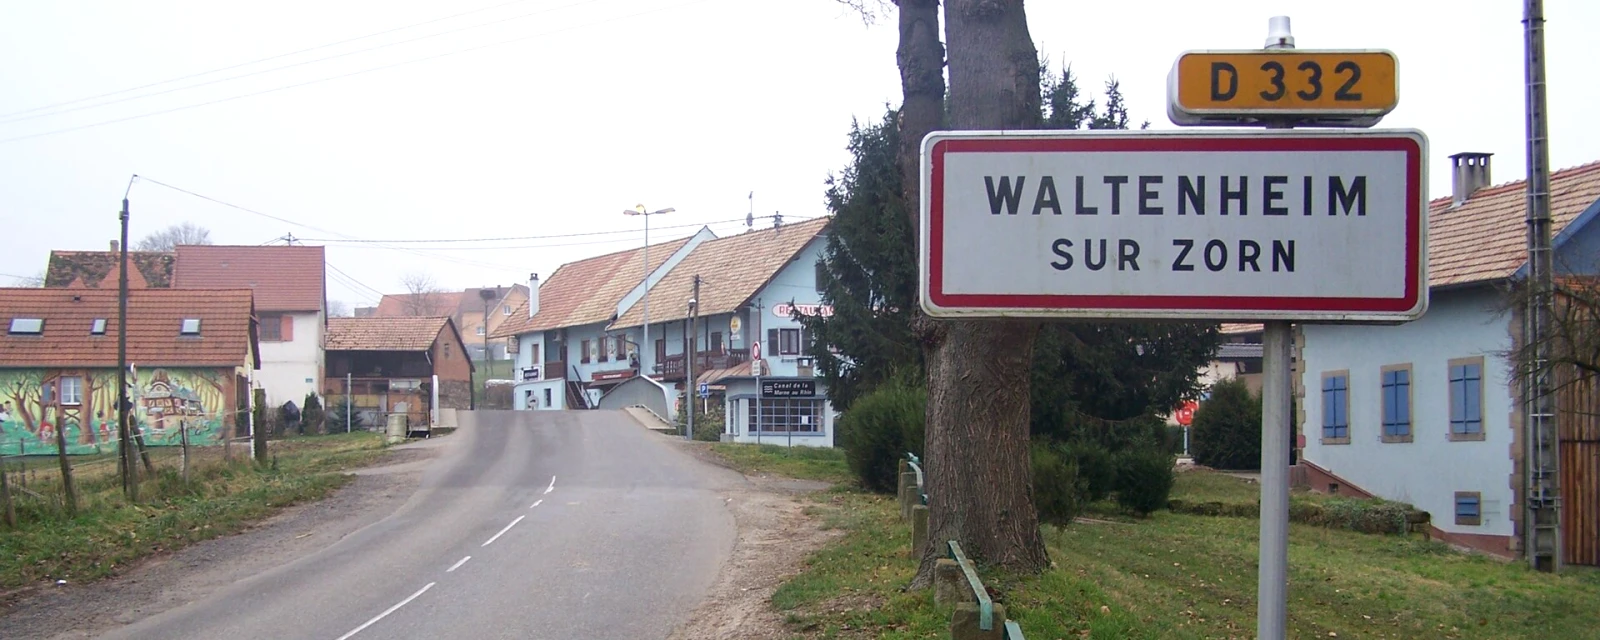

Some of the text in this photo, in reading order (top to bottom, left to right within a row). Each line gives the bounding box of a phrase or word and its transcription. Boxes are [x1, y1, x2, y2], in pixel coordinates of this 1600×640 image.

[1211, 61, 1362, 101] D 332
[984, 175, 1367, 216] WALTENHEIM
[1050, 238, 1295, 272] SUR ZORN
